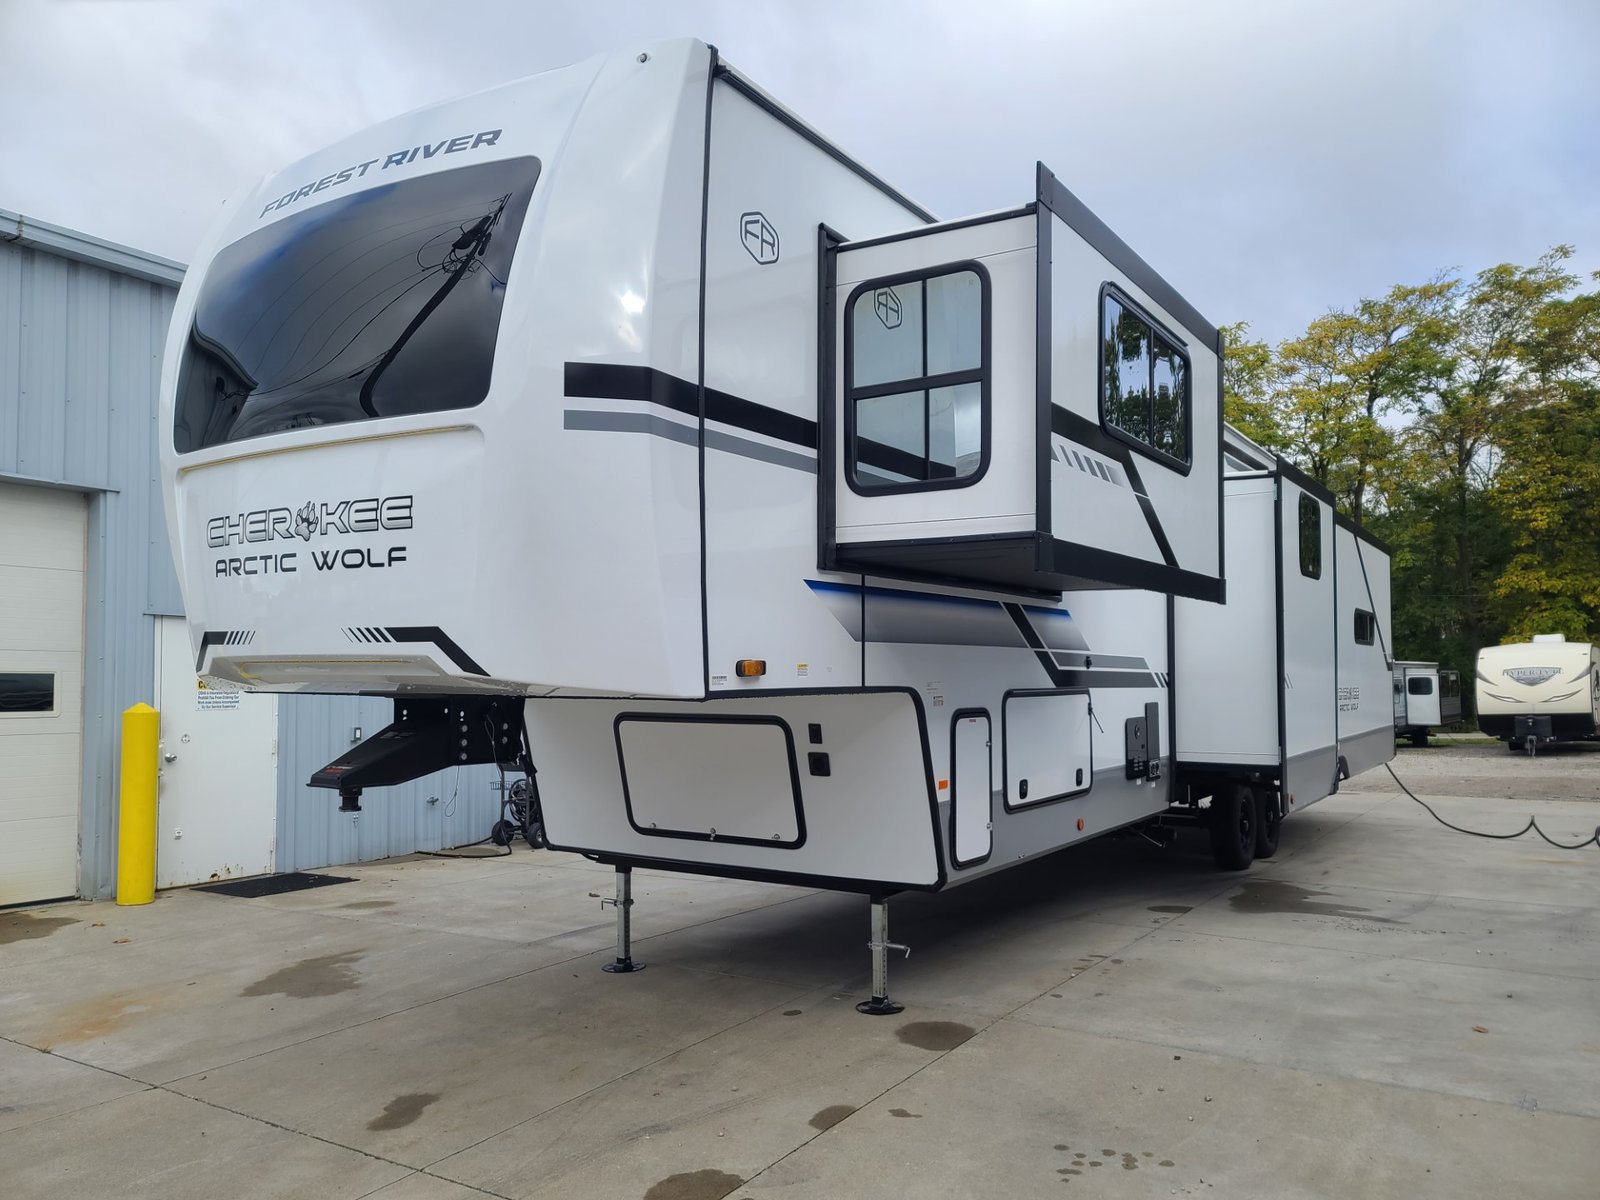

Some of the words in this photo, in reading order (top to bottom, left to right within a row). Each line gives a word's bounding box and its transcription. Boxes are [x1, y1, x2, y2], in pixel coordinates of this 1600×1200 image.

[258, 158, 380, 219] FOREST
[381, 129, 503, 170] RIVER
[215, 552, 297, 578] ARCTIC
[311, 546, 408, 571] WOLF
